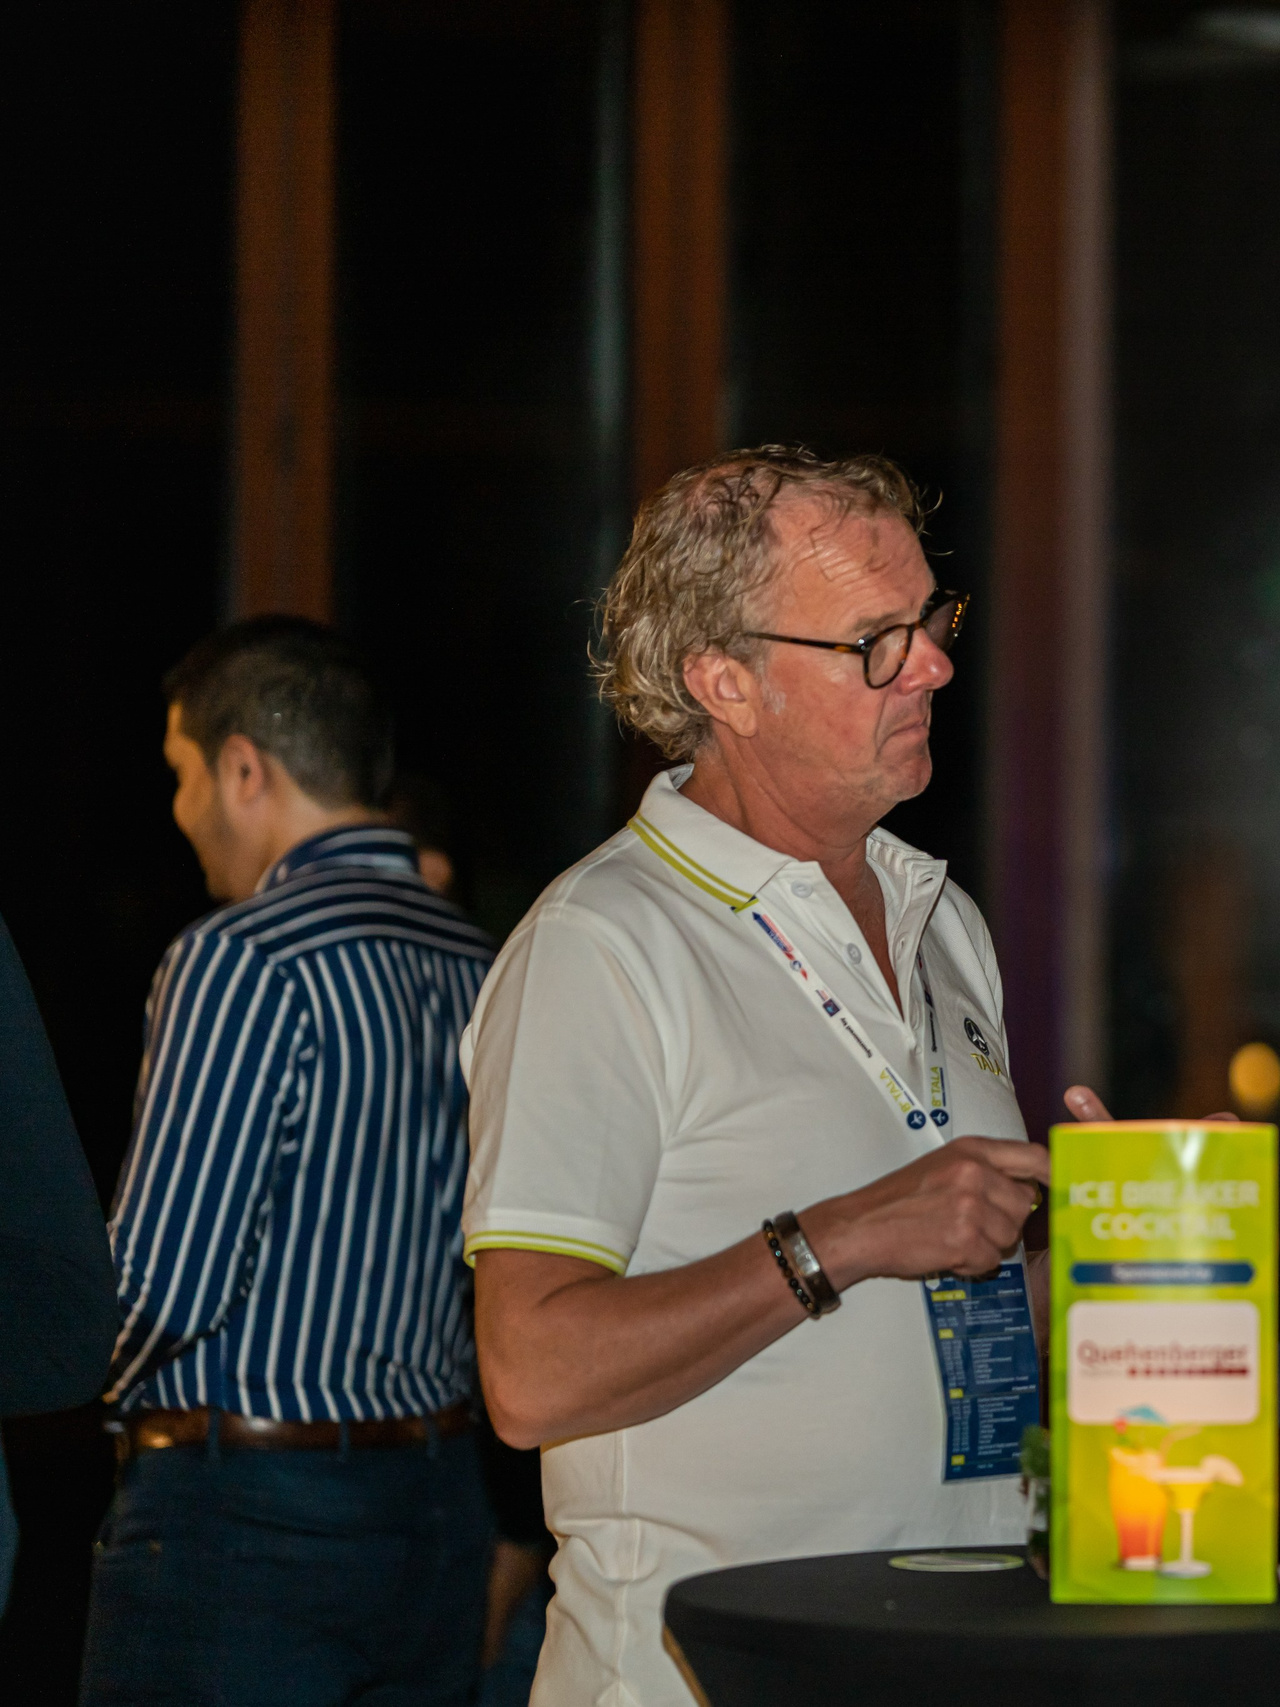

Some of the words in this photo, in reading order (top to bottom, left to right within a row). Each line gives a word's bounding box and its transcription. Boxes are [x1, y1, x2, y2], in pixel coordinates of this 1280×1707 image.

[879, 1069, 903, 1102] TALA
[930, 1066, 941, 1094] TALA
[1069, 1180, 1115, 1208] ICE
[1122, 1180, 1260, 1209] BREAKER
[1091, 1213, 1236, 1241] COCKTAIL
